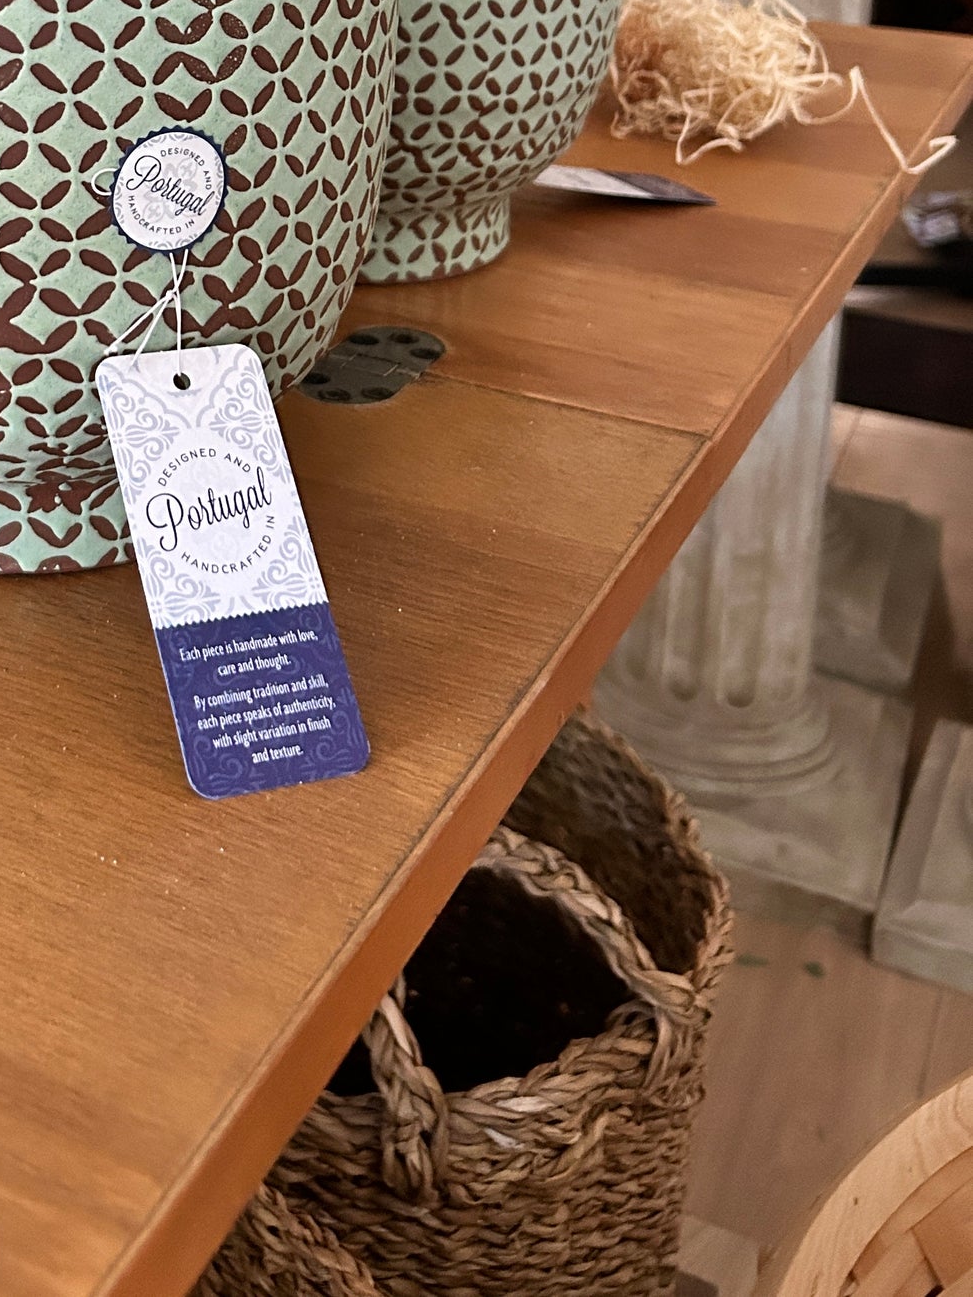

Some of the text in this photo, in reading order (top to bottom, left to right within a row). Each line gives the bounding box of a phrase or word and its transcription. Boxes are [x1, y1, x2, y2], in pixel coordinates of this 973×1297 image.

[126, 154, 215, 216] Portugal
[160, 147, 212, 190] DESIGNED AND
[128, 195, 195, 235] HANDCRAFTED IN
[158, 448, 251, 487] DESIGNED AND
[146, 466, 272, 552] Portugal
[181, 515, 275, 574] HANDCRAFTED IN
[179, 628, 318, 662] Each piece is handmade with love,
[217, 653, 292, 676] care and thought.
[193, 673, 329, 712] By combining tradition and skill,
[197, 695, 336, 731] each piece speaks of authenticity,
[212, 715, 332, 749] with slight variation in finish
[251, 744, 304, 764] and texture.
